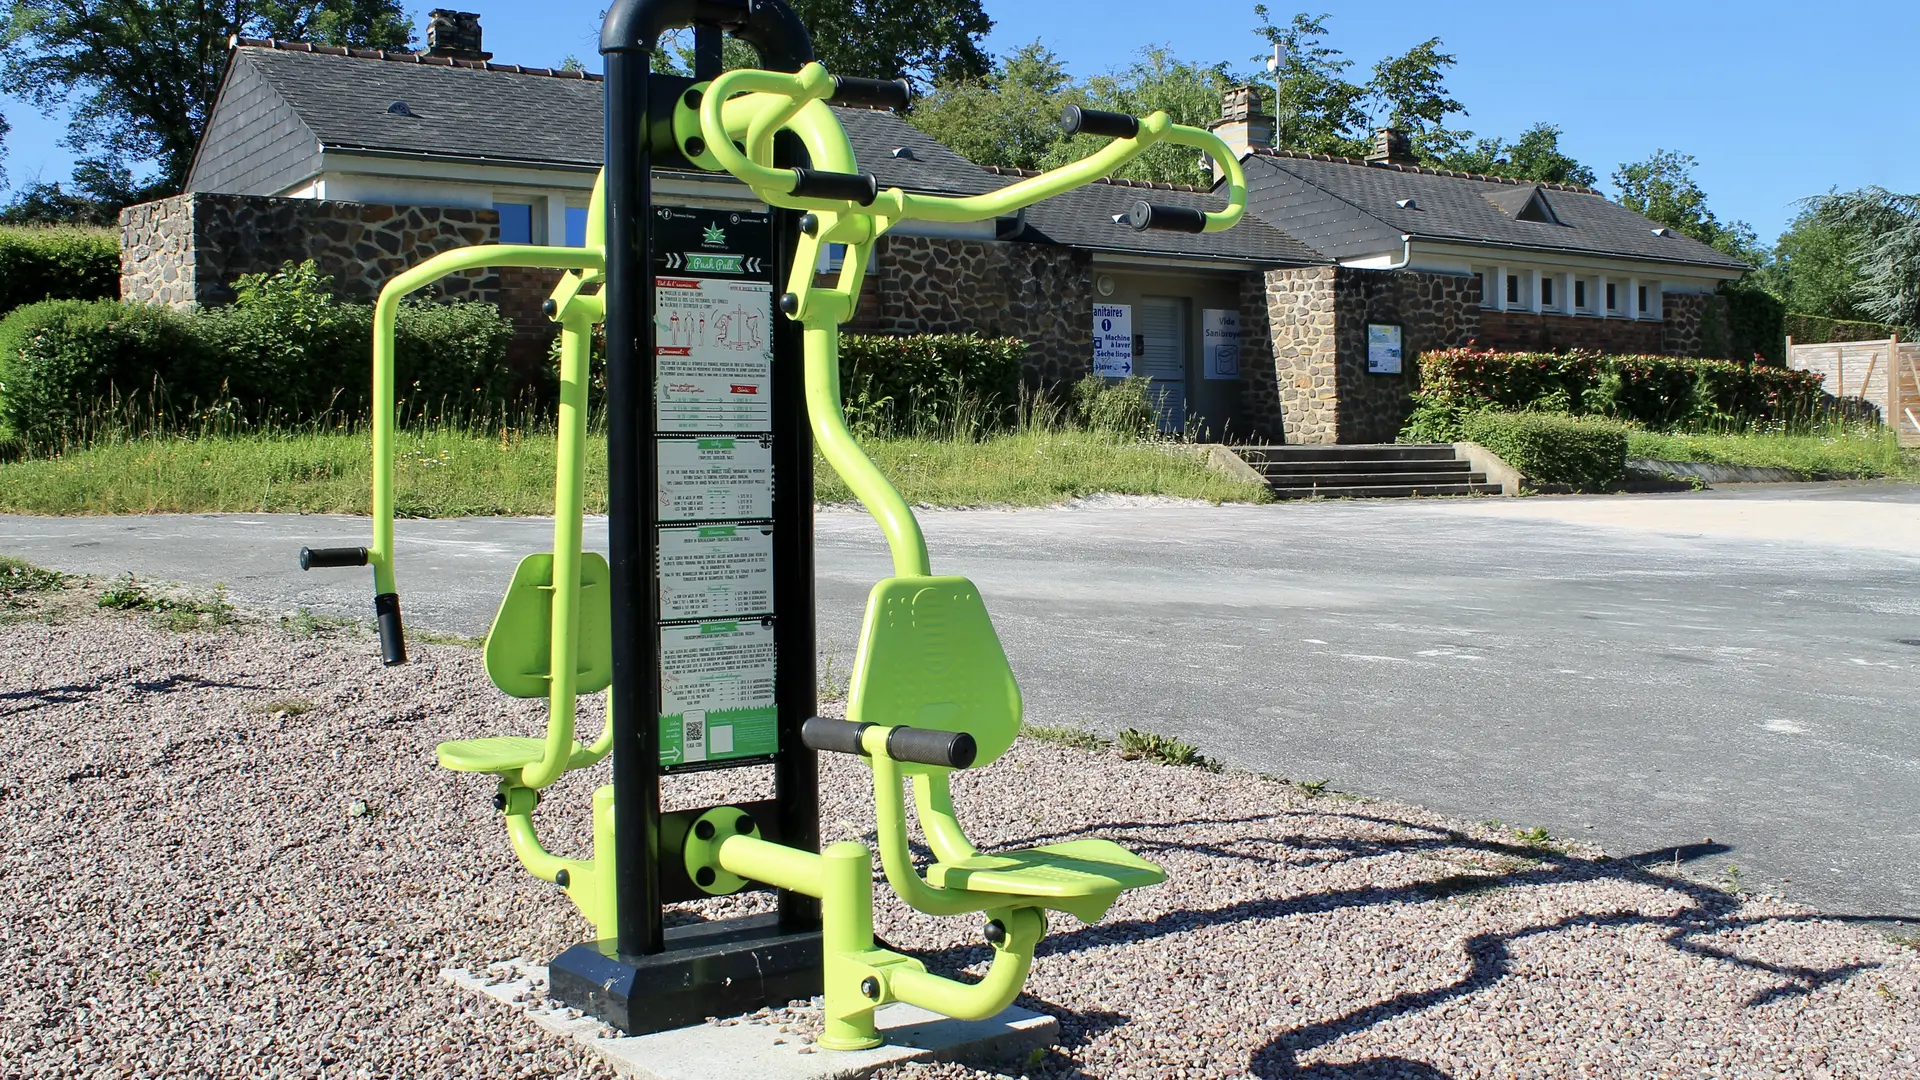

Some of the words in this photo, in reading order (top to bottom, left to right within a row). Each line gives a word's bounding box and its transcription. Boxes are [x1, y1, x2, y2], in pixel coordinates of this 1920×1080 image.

[693, 258, 715, 269] Push
[715, 259, 734, 271] Pull
[1093, 306, 1123, 317] anitaires
[1219, 317, 1235, 326] Vide
[1115, 350, 1130, 359] linge
